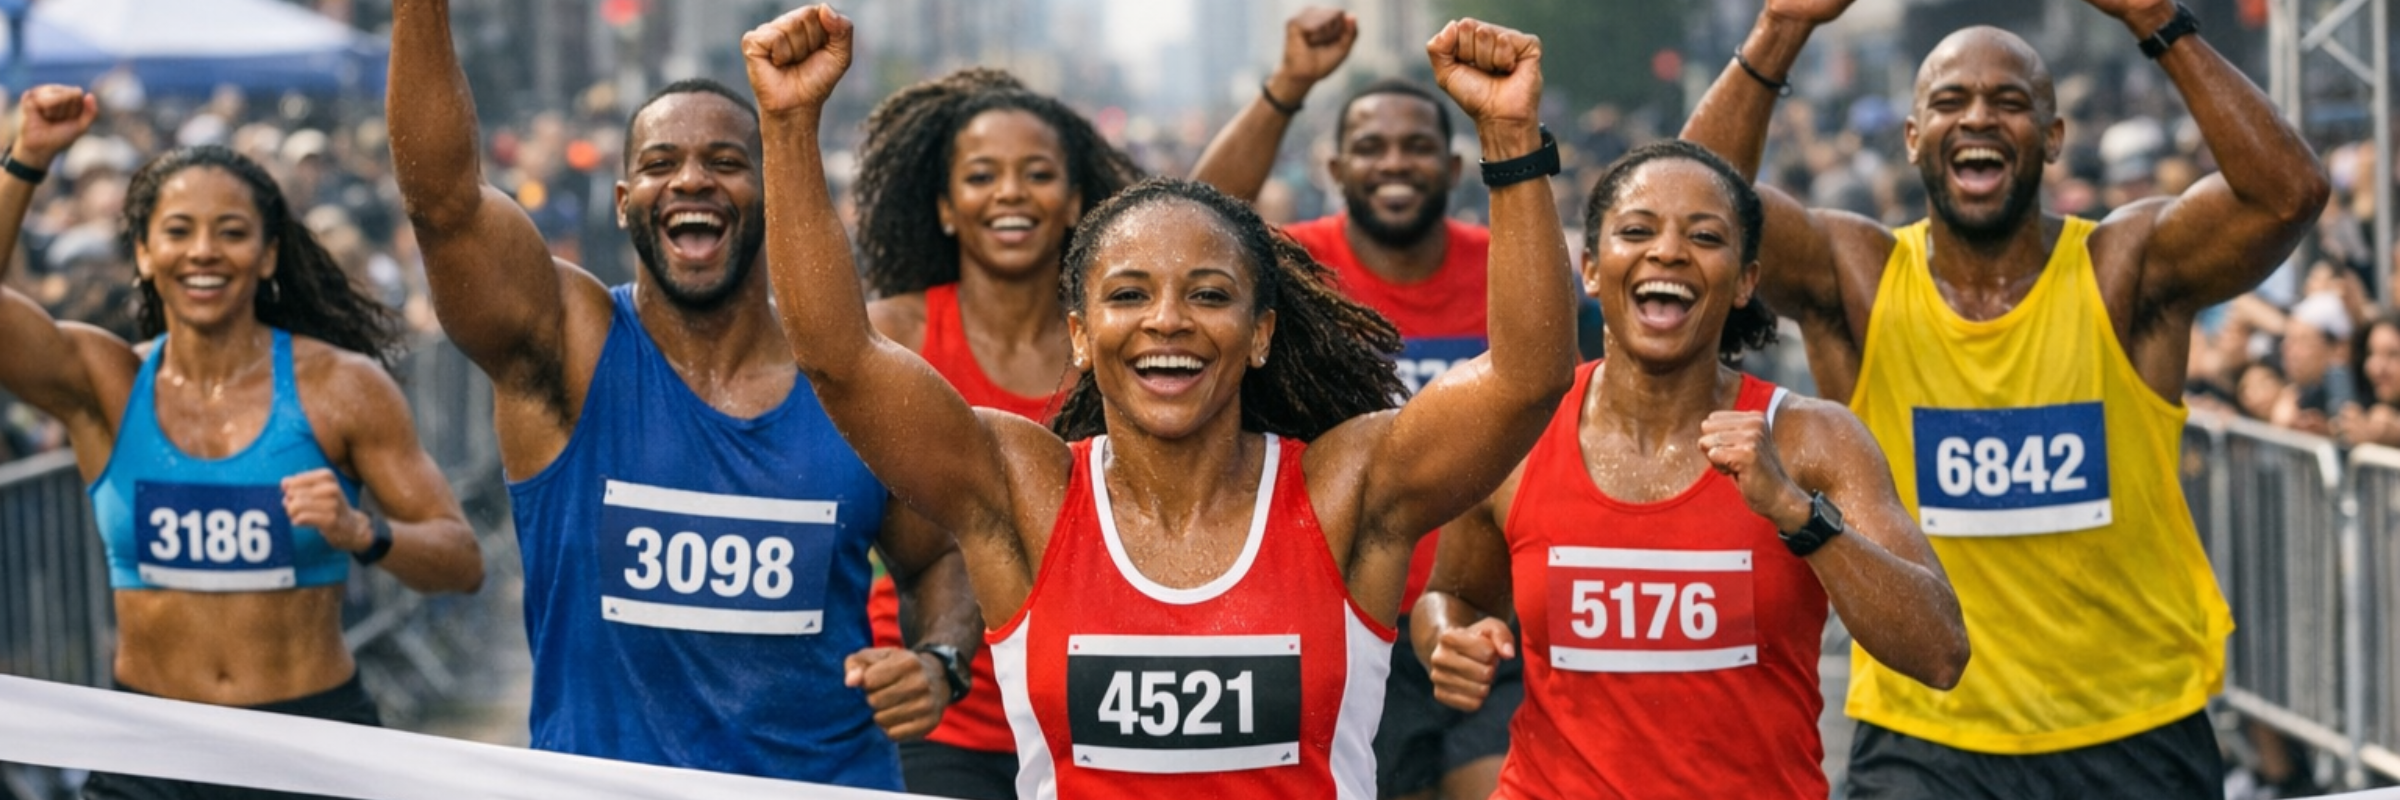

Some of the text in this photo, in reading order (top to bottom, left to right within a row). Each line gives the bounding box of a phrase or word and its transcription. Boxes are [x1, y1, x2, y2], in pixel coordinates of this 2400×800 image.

[1937, 433, 2087, 496] 6842
[149, 507, 272, 563] 3186
[624, 527, 794, 599] 3098
[1571, 580, 1718, 640] 5176
[1098, 669, 1254, 736] 4521
